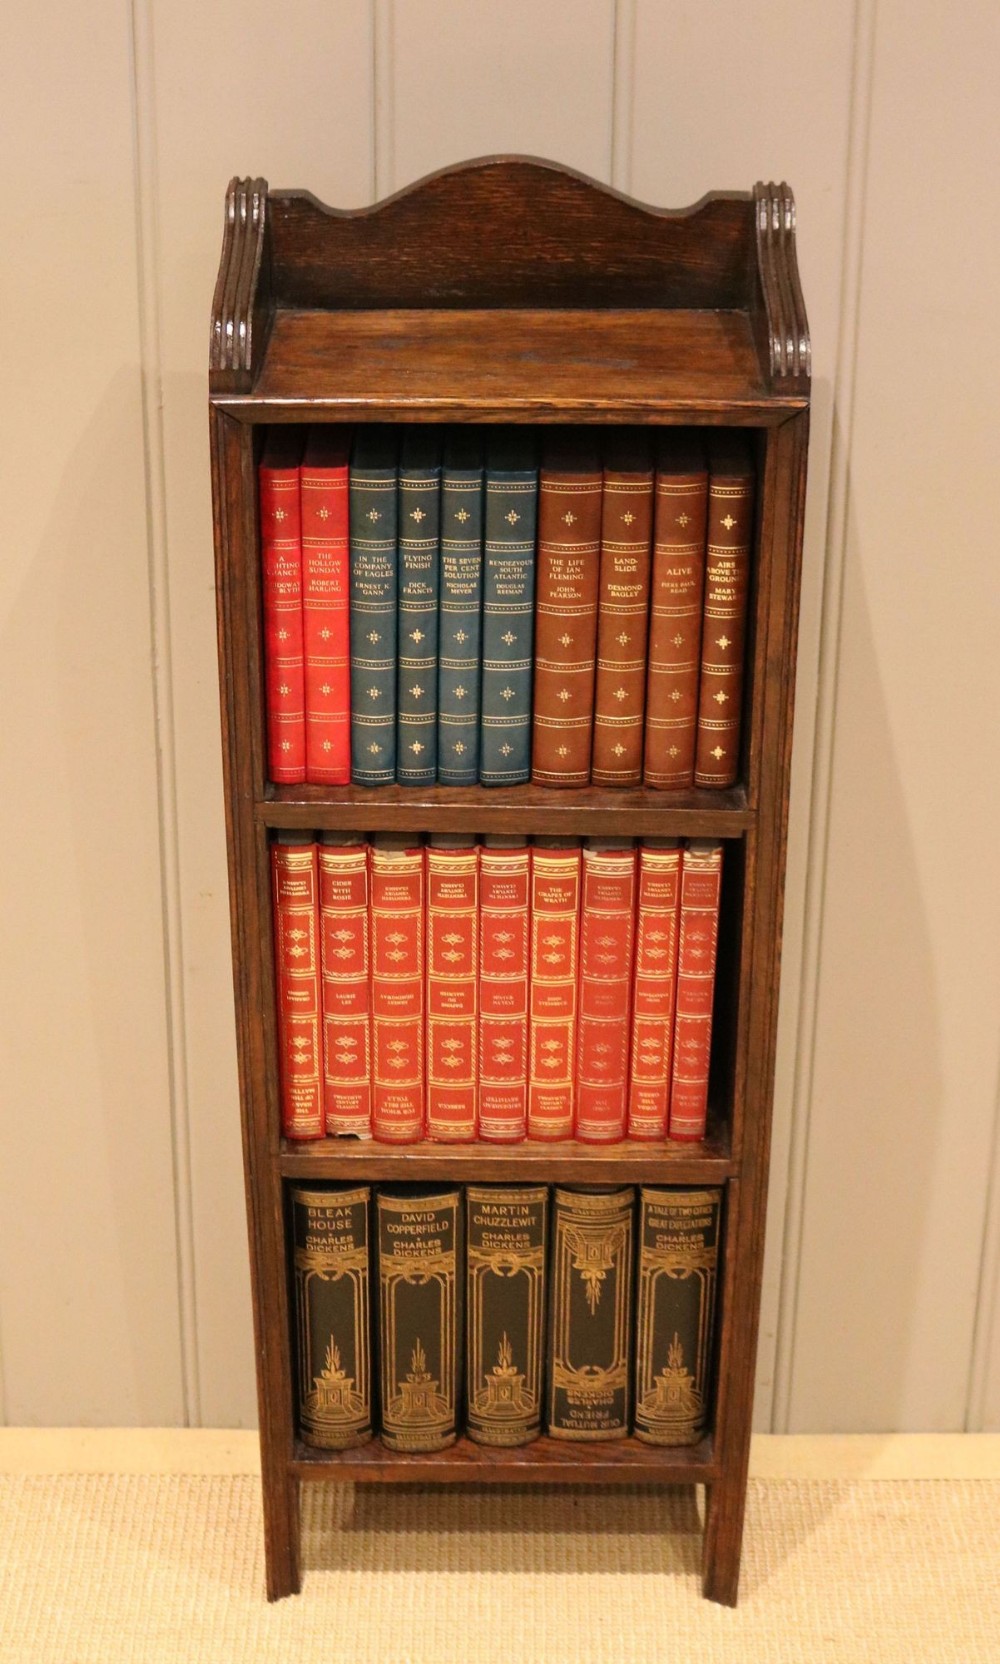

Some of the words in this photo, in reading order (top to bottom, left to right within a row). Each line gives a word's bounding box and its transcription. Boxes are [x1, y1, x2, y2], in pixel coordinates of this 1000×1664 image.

[308, 559, 341, 567] HOLLOW
[354, 562, 392, 570] COMPANY
[406, 561, 431, 569] FINISH
[549, 558, 564, 566] THE
[309, 566, 341, 574] SUNDAY
[460, 564, 480, 572] CENT
[615, 564, 637, 572] SLIDE
[666, 568, 692, 576] ALIVE
[706, 567, 731, 576] ABOVE
[365, 569, 393, 577] EAGLES
[444, 571, 479, 579] SOLUTION
[549, 572, 584, 580] FLEMING
[709, 575, 740, 583] GROUN
[355, 582, 381, 590] ERNEST
[610, 590, 639, 598] BAGLEY
[709, 593, 739, 601] STEWAR
[308, 1207, 353, 1217] BLEAK
[481, 1205, 529, 1215] MARTIN
[647, 1205, 653, 1214] A
[668, 1207, 676, 1216] OF
[677, 1207, 693, 1216] TWO
[401, 1213, 435, 1223] DAVID
[473, 1215, 537, 1227] CHUZZLEWIT
[308, 1219, 353, 1230] HOUSE
[387, 1221, 449, 1234] COPPERFIELD
[648, 1218, 668, 1229] GREAT
[306, 1234, 354, 1244] CHARLES
[482, 1232, 530, 1241] CHARLES
[656, 1234, 704, 1242] CHARLES
[306, 1243, 354, 1252] DICKENS
[393, 1239, 441, 1249] CHARLES
[481, 1240, 530, 1249] DICKENS
[655, 1242, 704, 1251] DICKENS
[394, 1248, 441, 1256] DICKENS
[567, 1389, 614, 1398] DICKENS
[567, 1397, 614, 1405] CHARLES
[569, 1409, 610, 1419] FRIEND
[560, 1417, 598, 1429] MUTUAL
[600, 1418, 620, 1429] OUR
